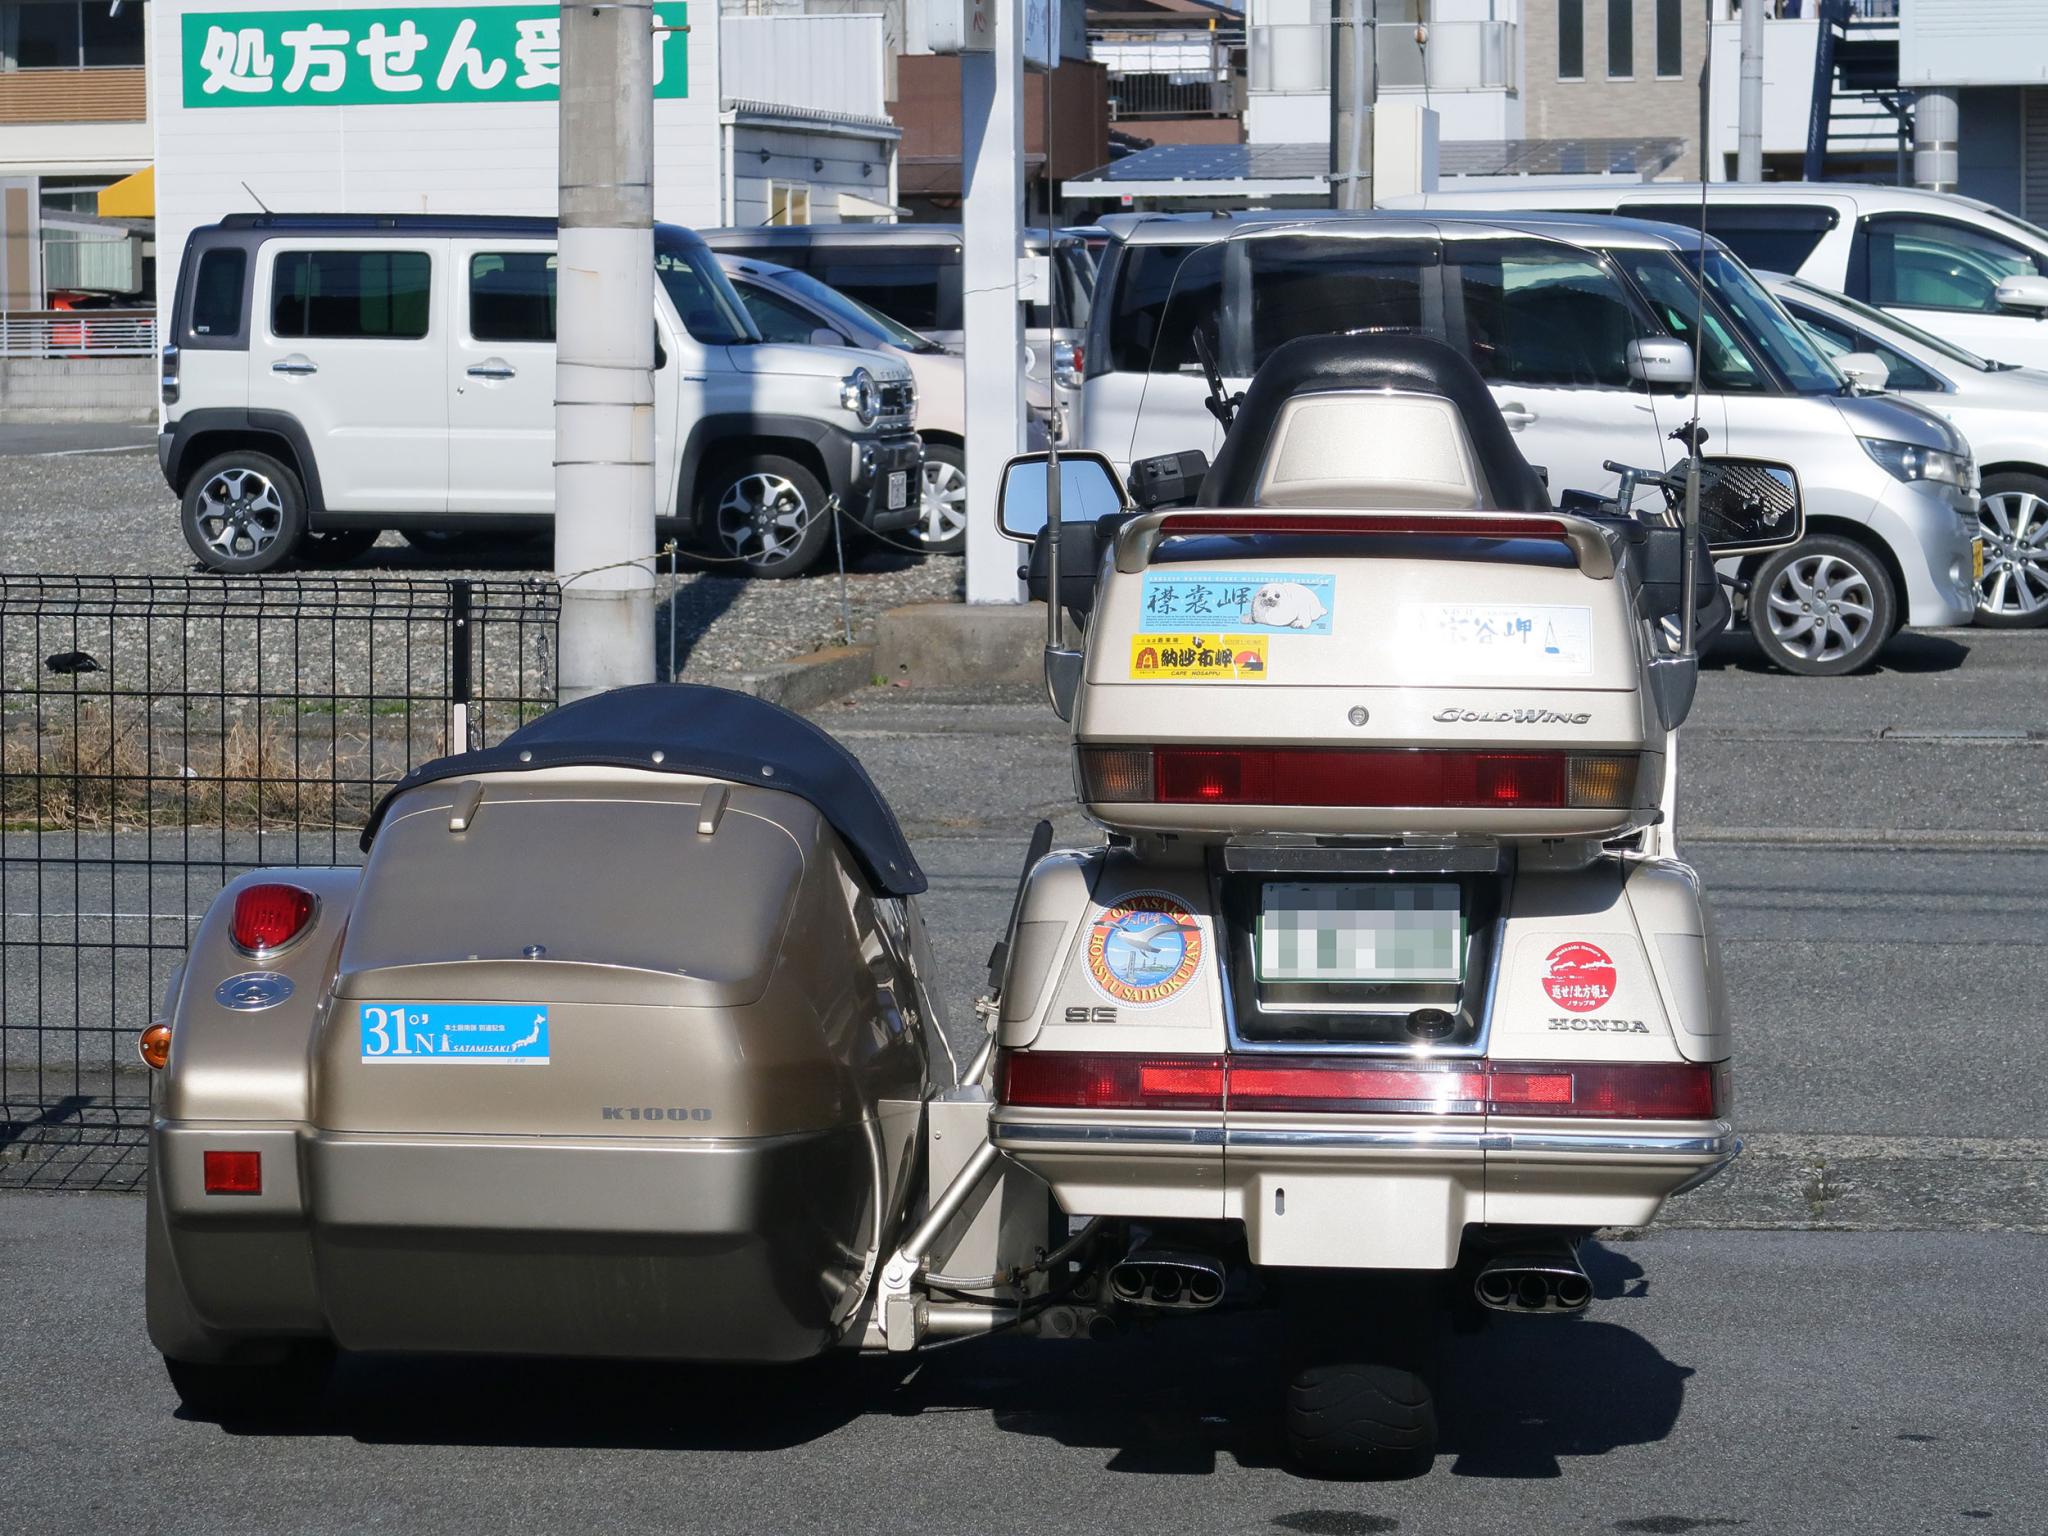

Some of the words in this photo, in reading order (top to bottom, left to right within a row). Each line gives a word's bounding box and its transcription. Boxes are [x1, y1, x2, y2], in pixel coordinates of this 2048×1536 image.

[1147, 584, 1252, 614] 襟裳岬
[1110, 897, 1190, 925] OMASAKI
[1088, 934, 1121, 994] HONSYU
[1121, 939, 1200, 1003] SAIHOKUTAN
[1065, 1006, 1118, 1024] SE
[1548, 1018, 1650, 1034] HONDA
[453, 1045, 511, 1053] SATAMISAKI
[602, 1107, 714, 1121] K1000
